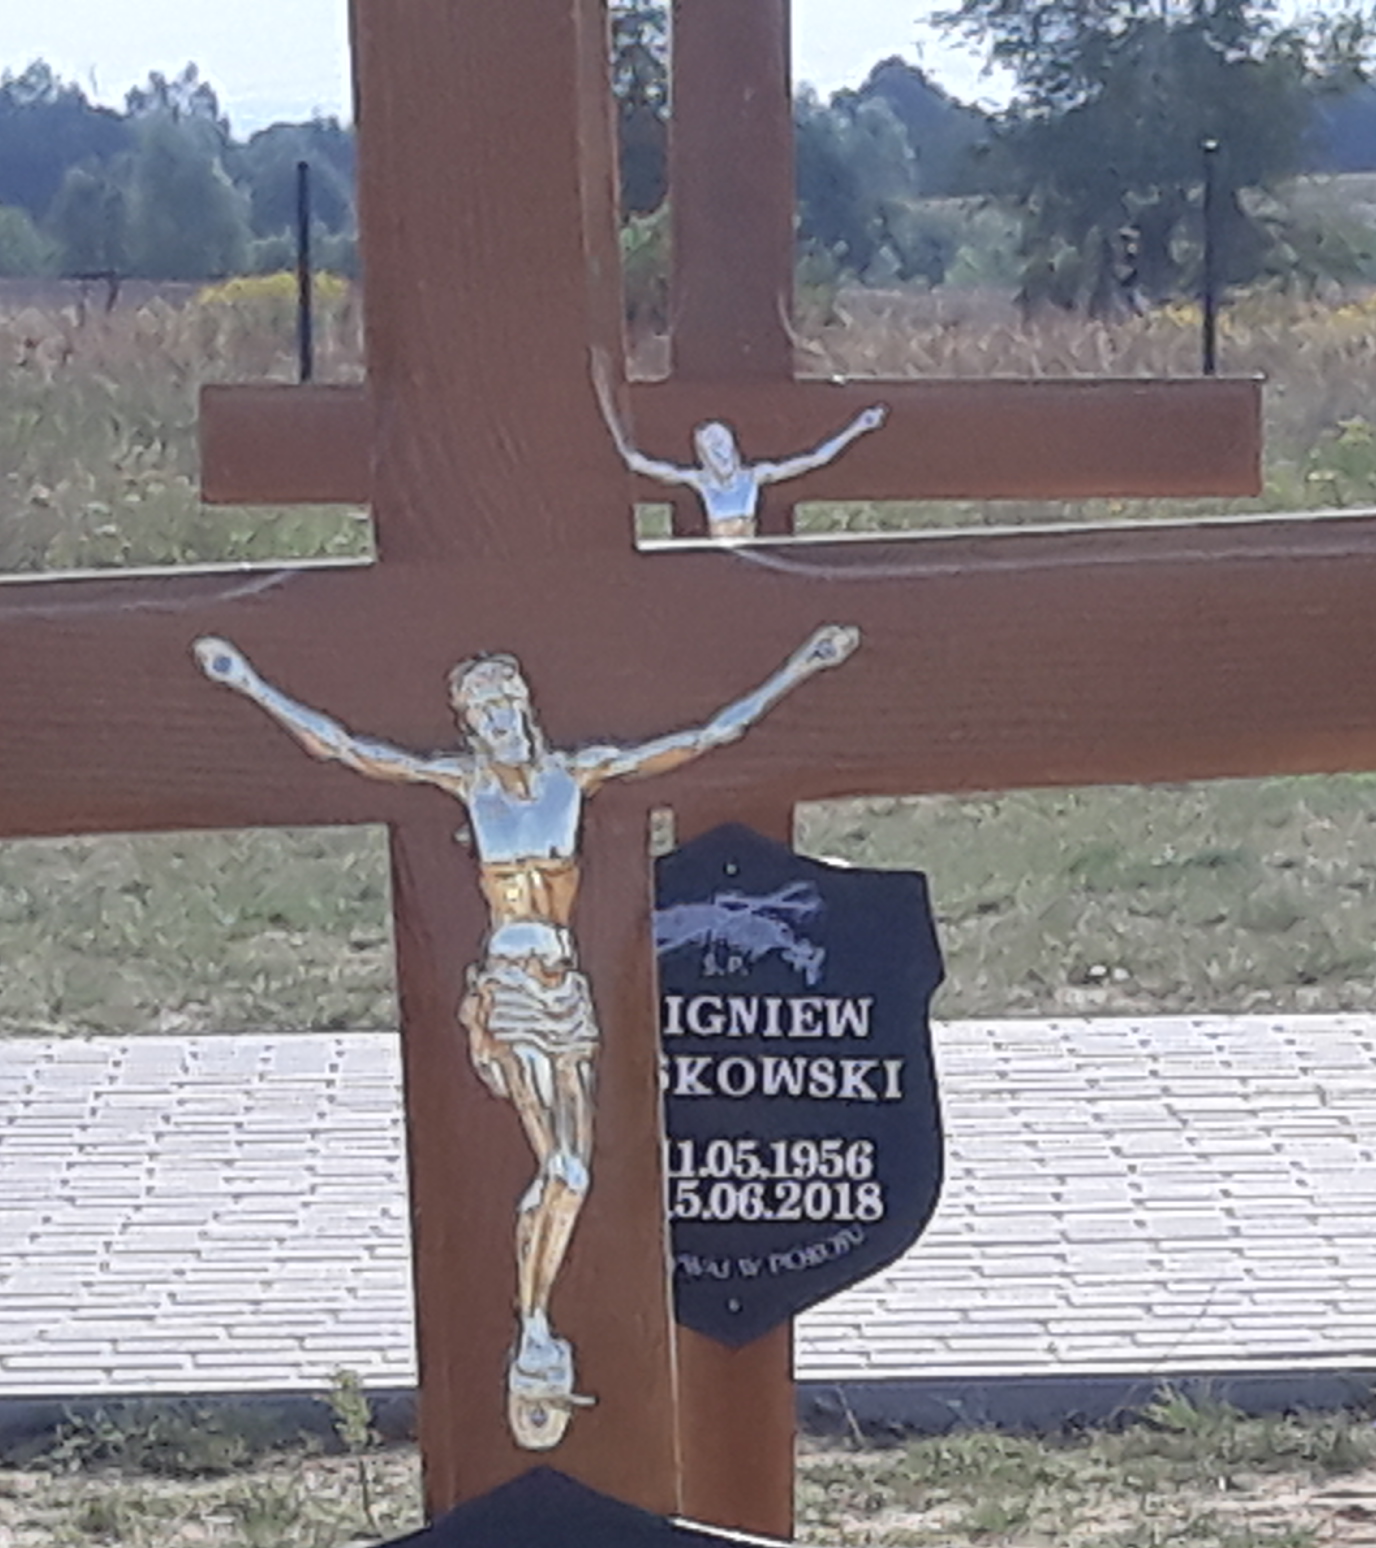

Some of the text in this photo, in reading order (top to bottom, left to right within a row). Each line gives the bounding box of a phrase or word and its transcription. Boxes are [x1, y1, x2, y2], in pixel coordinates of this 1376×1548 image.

[663, 995, 873, 1037] IGNIEW
[668, 1139, 873, 1179] 1.05.1956
[668, 1180, 884, 1221] 5.06.2018
